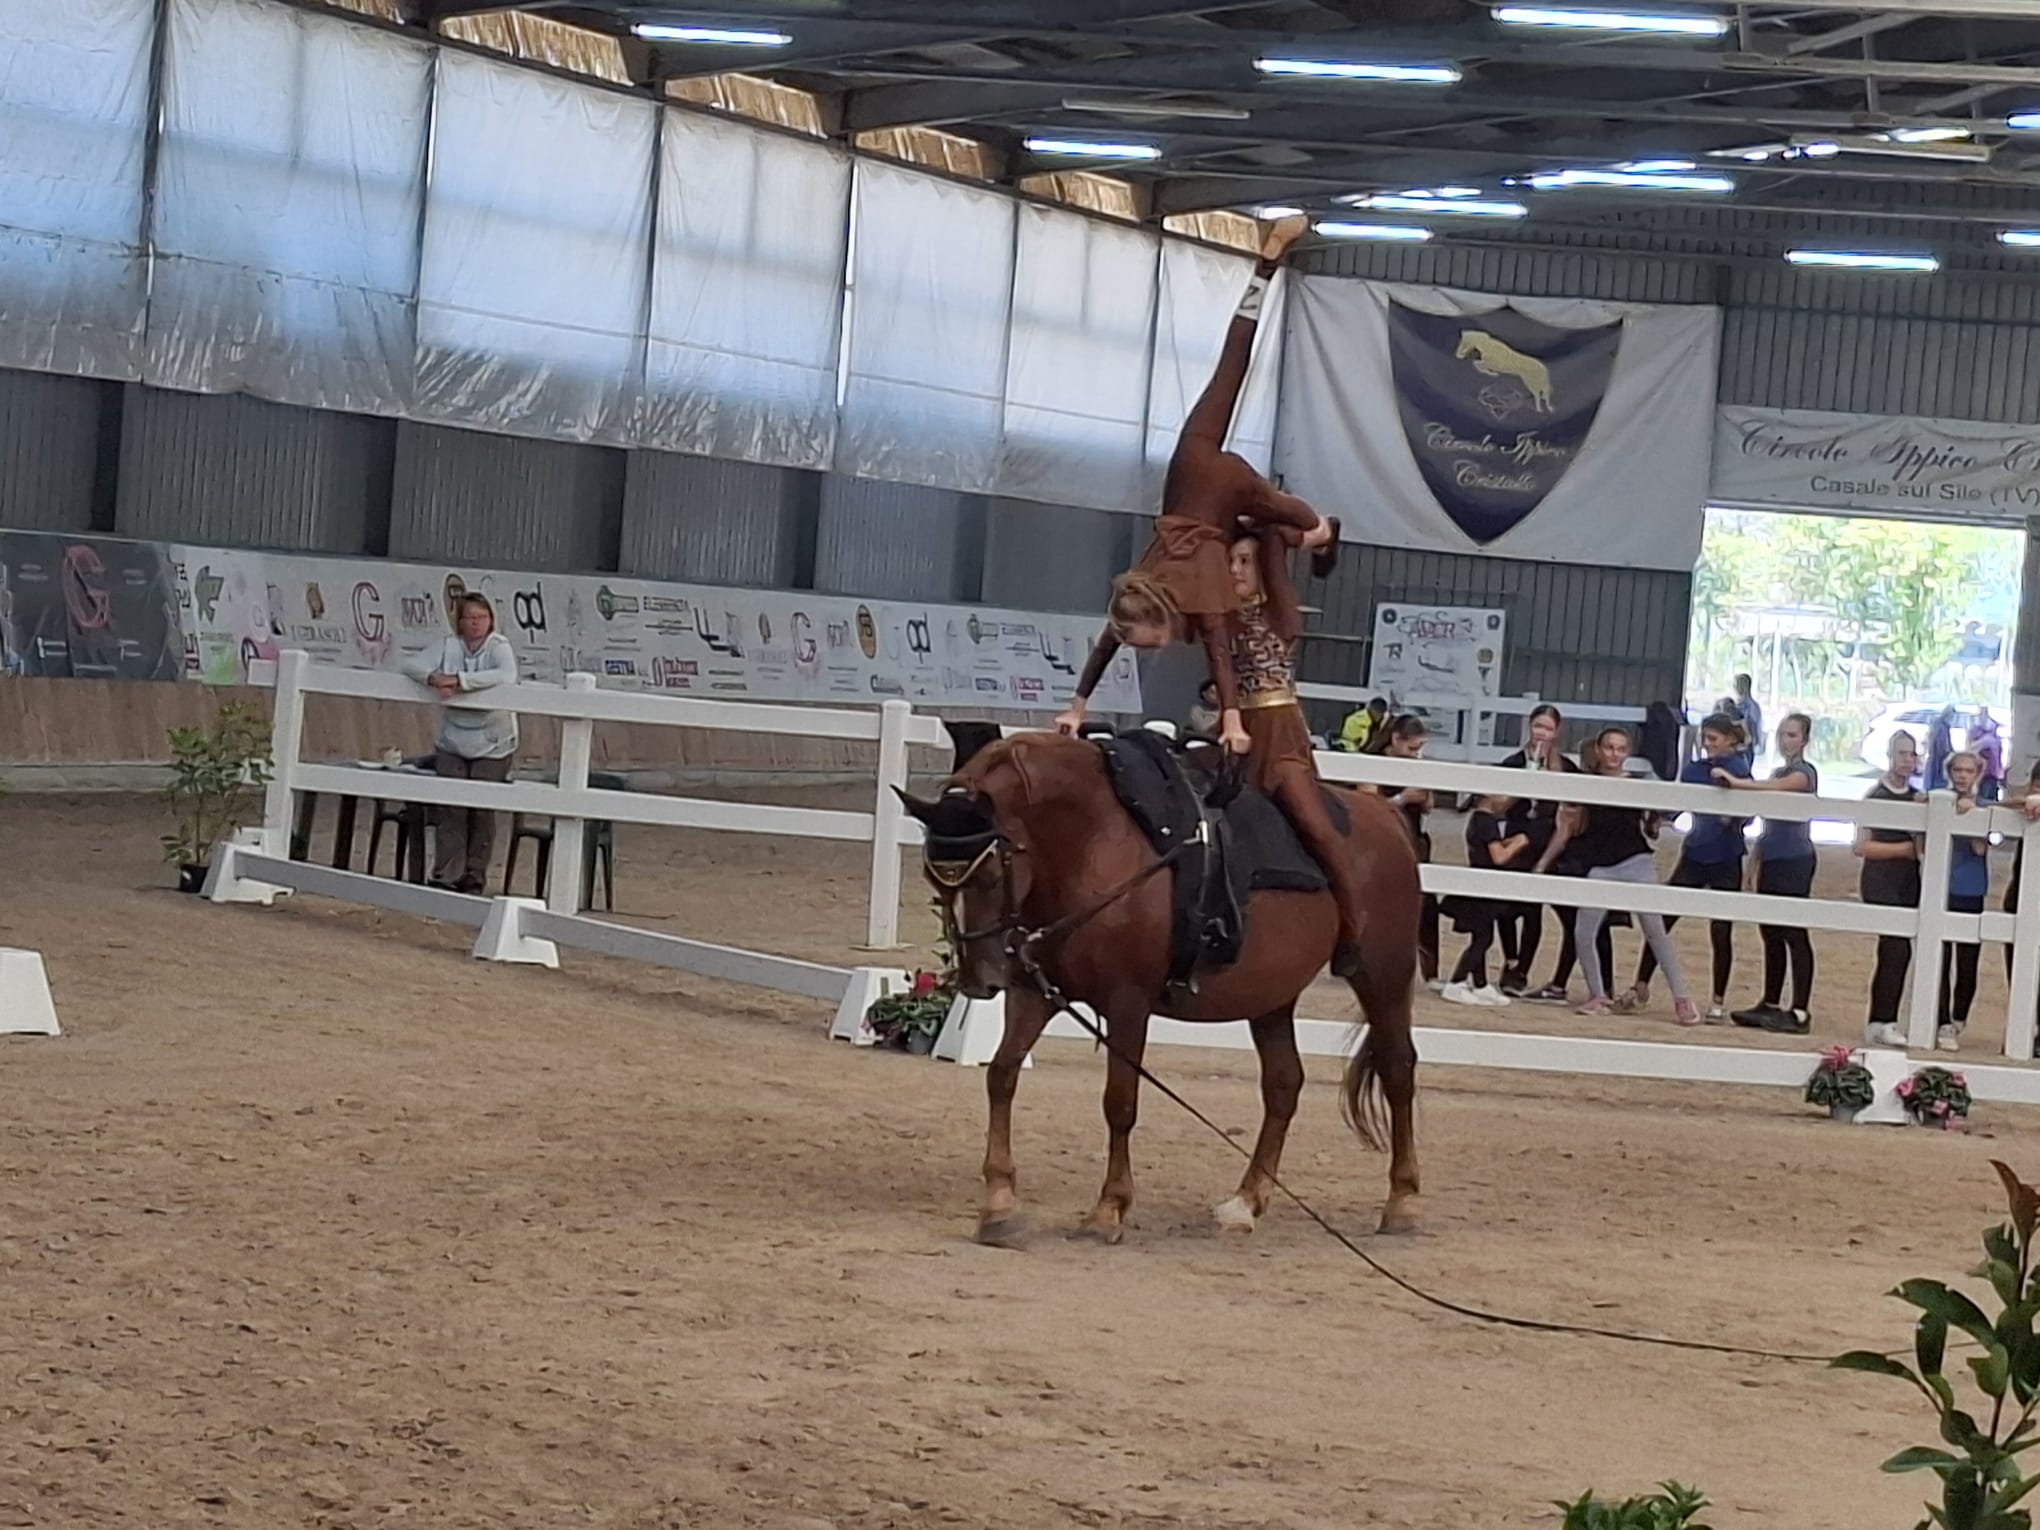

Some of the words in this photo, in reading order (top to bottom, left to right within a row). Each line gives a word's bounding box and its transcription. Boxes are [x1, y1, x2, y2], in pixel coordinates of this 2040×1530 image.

[1810, 474, 1891, 497] Casale
[1898, 482, 1931, 499] sul
[1939, 481, 1983, 502] Sile
